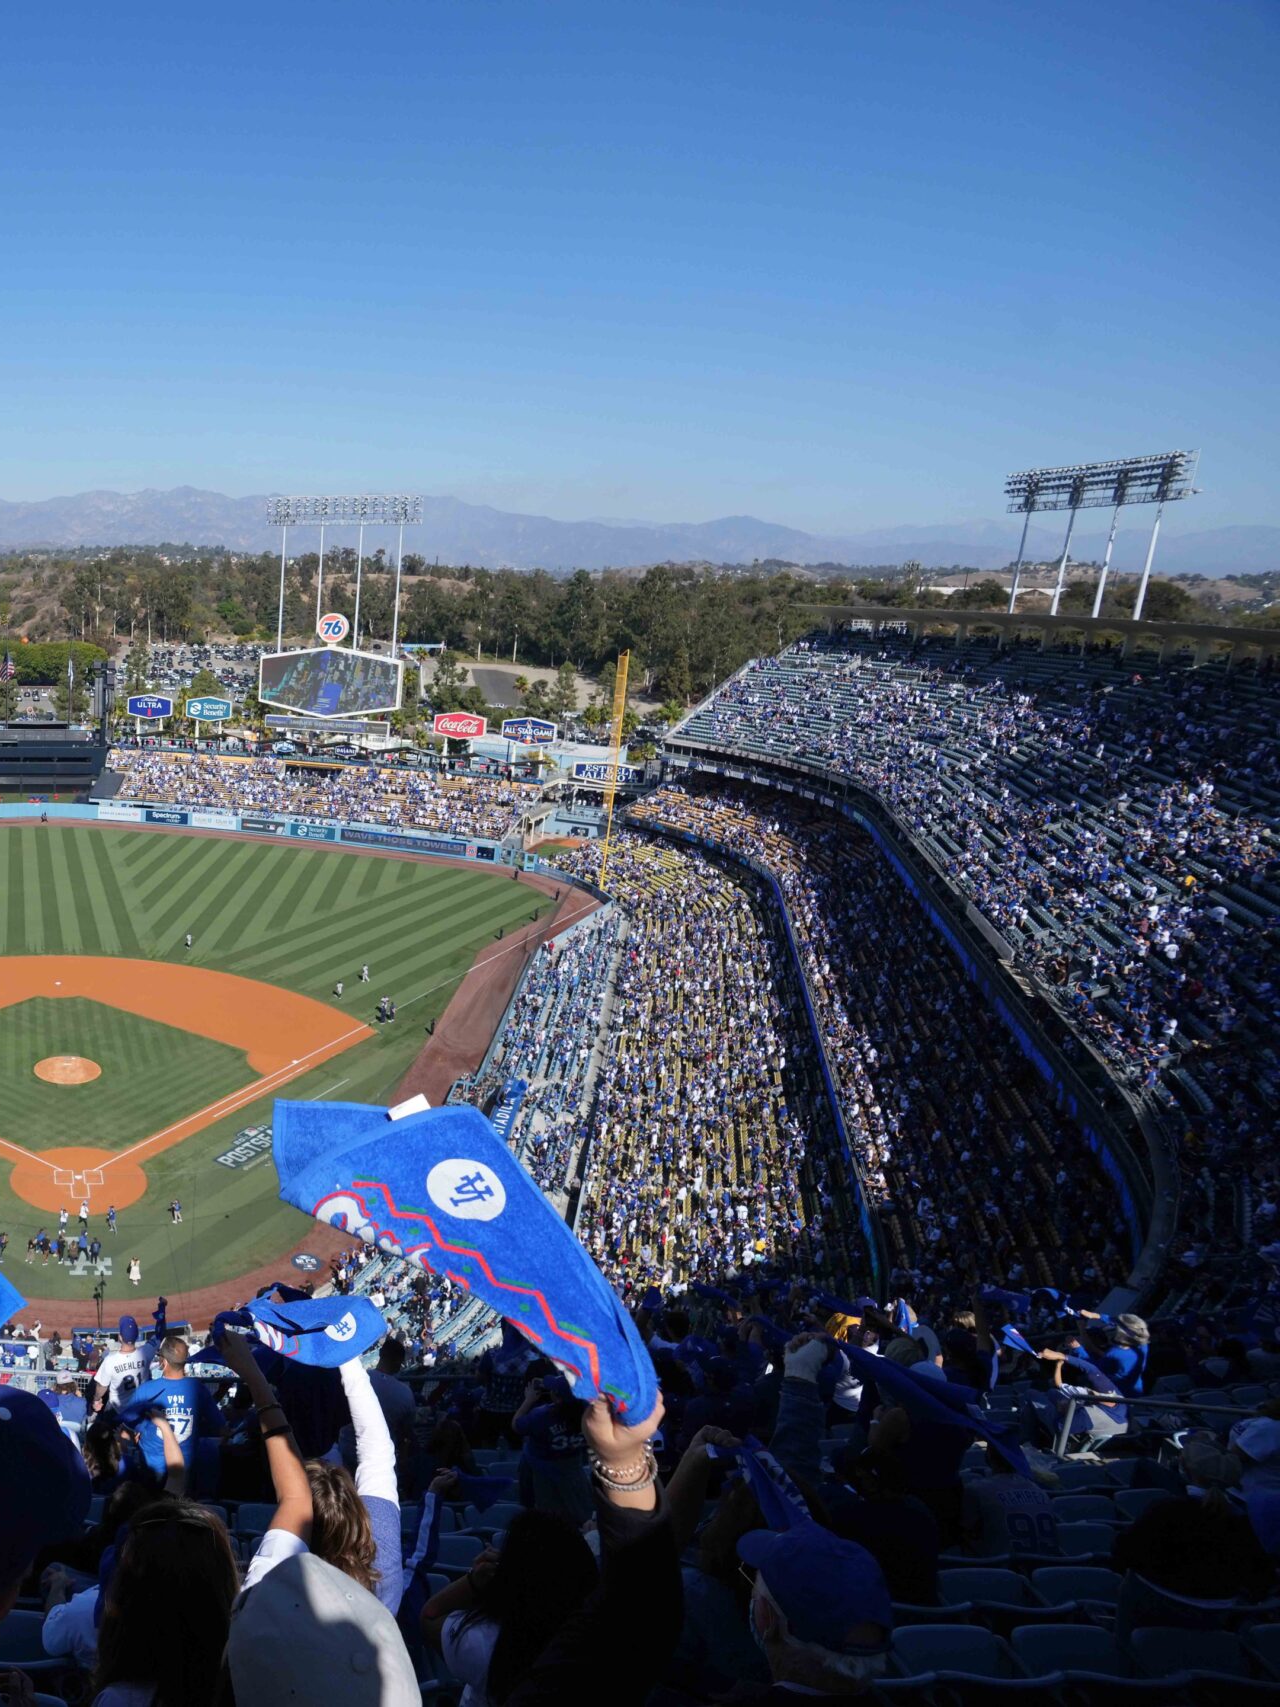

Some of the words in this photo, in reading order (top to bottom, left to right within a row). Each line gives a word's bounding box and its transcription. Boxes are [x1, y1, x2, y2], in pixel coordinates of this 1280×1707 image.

[323, 619, 343, 636] 76
[203, 703, 227, 711] Security
[533, 728, 554, 737] GAME
[152, 811, 181, 819] Spectrum
[343, 830, 374, 841] WAVE
[377, 833, 413, 845] THOSE
[123, 1371, 144, 1391] 21
[1006, 1512, 1057, 1554] 99
